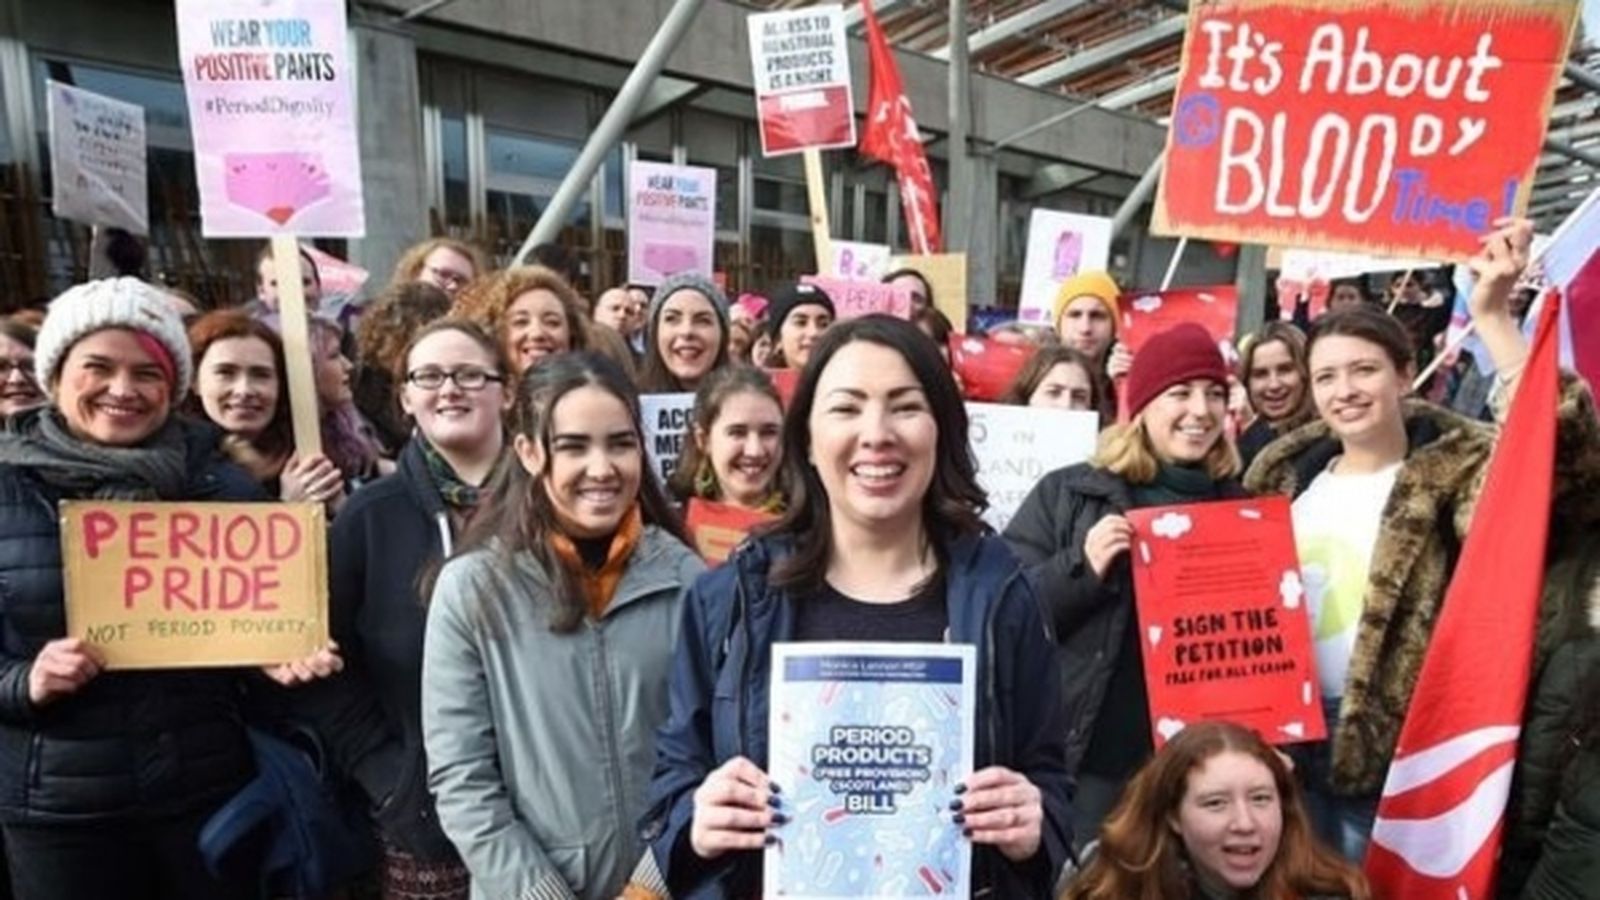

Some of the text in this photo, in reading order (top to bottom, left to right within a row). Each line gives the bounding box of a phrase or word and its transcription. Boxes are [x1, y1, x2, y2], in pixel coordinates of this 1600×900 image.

[210, 19, 312, 47] WEAR YOUR
[763, 15, 831, 36] ACCESS TO
[194, 53, 335, 81] POSITIVE PANTS
[766, 50, 834, 72] PRODUCTS
[1198, 20, 1502, 103] It's About
[82, 510, 302, 562] PERIOD
[123, 565, 280, 611] PRIDE
[85, 617, 307, 645] NOT PERIOD POVERTY
[1173, 606, 1279, 638] SIGN THE
[1174, 634, 1284, 667] PETITION
[832, 726, 914, 746] PERIOD
[813, 745, 931, 765] PRODUCTS
[847, 794, 896, 813] BILL
